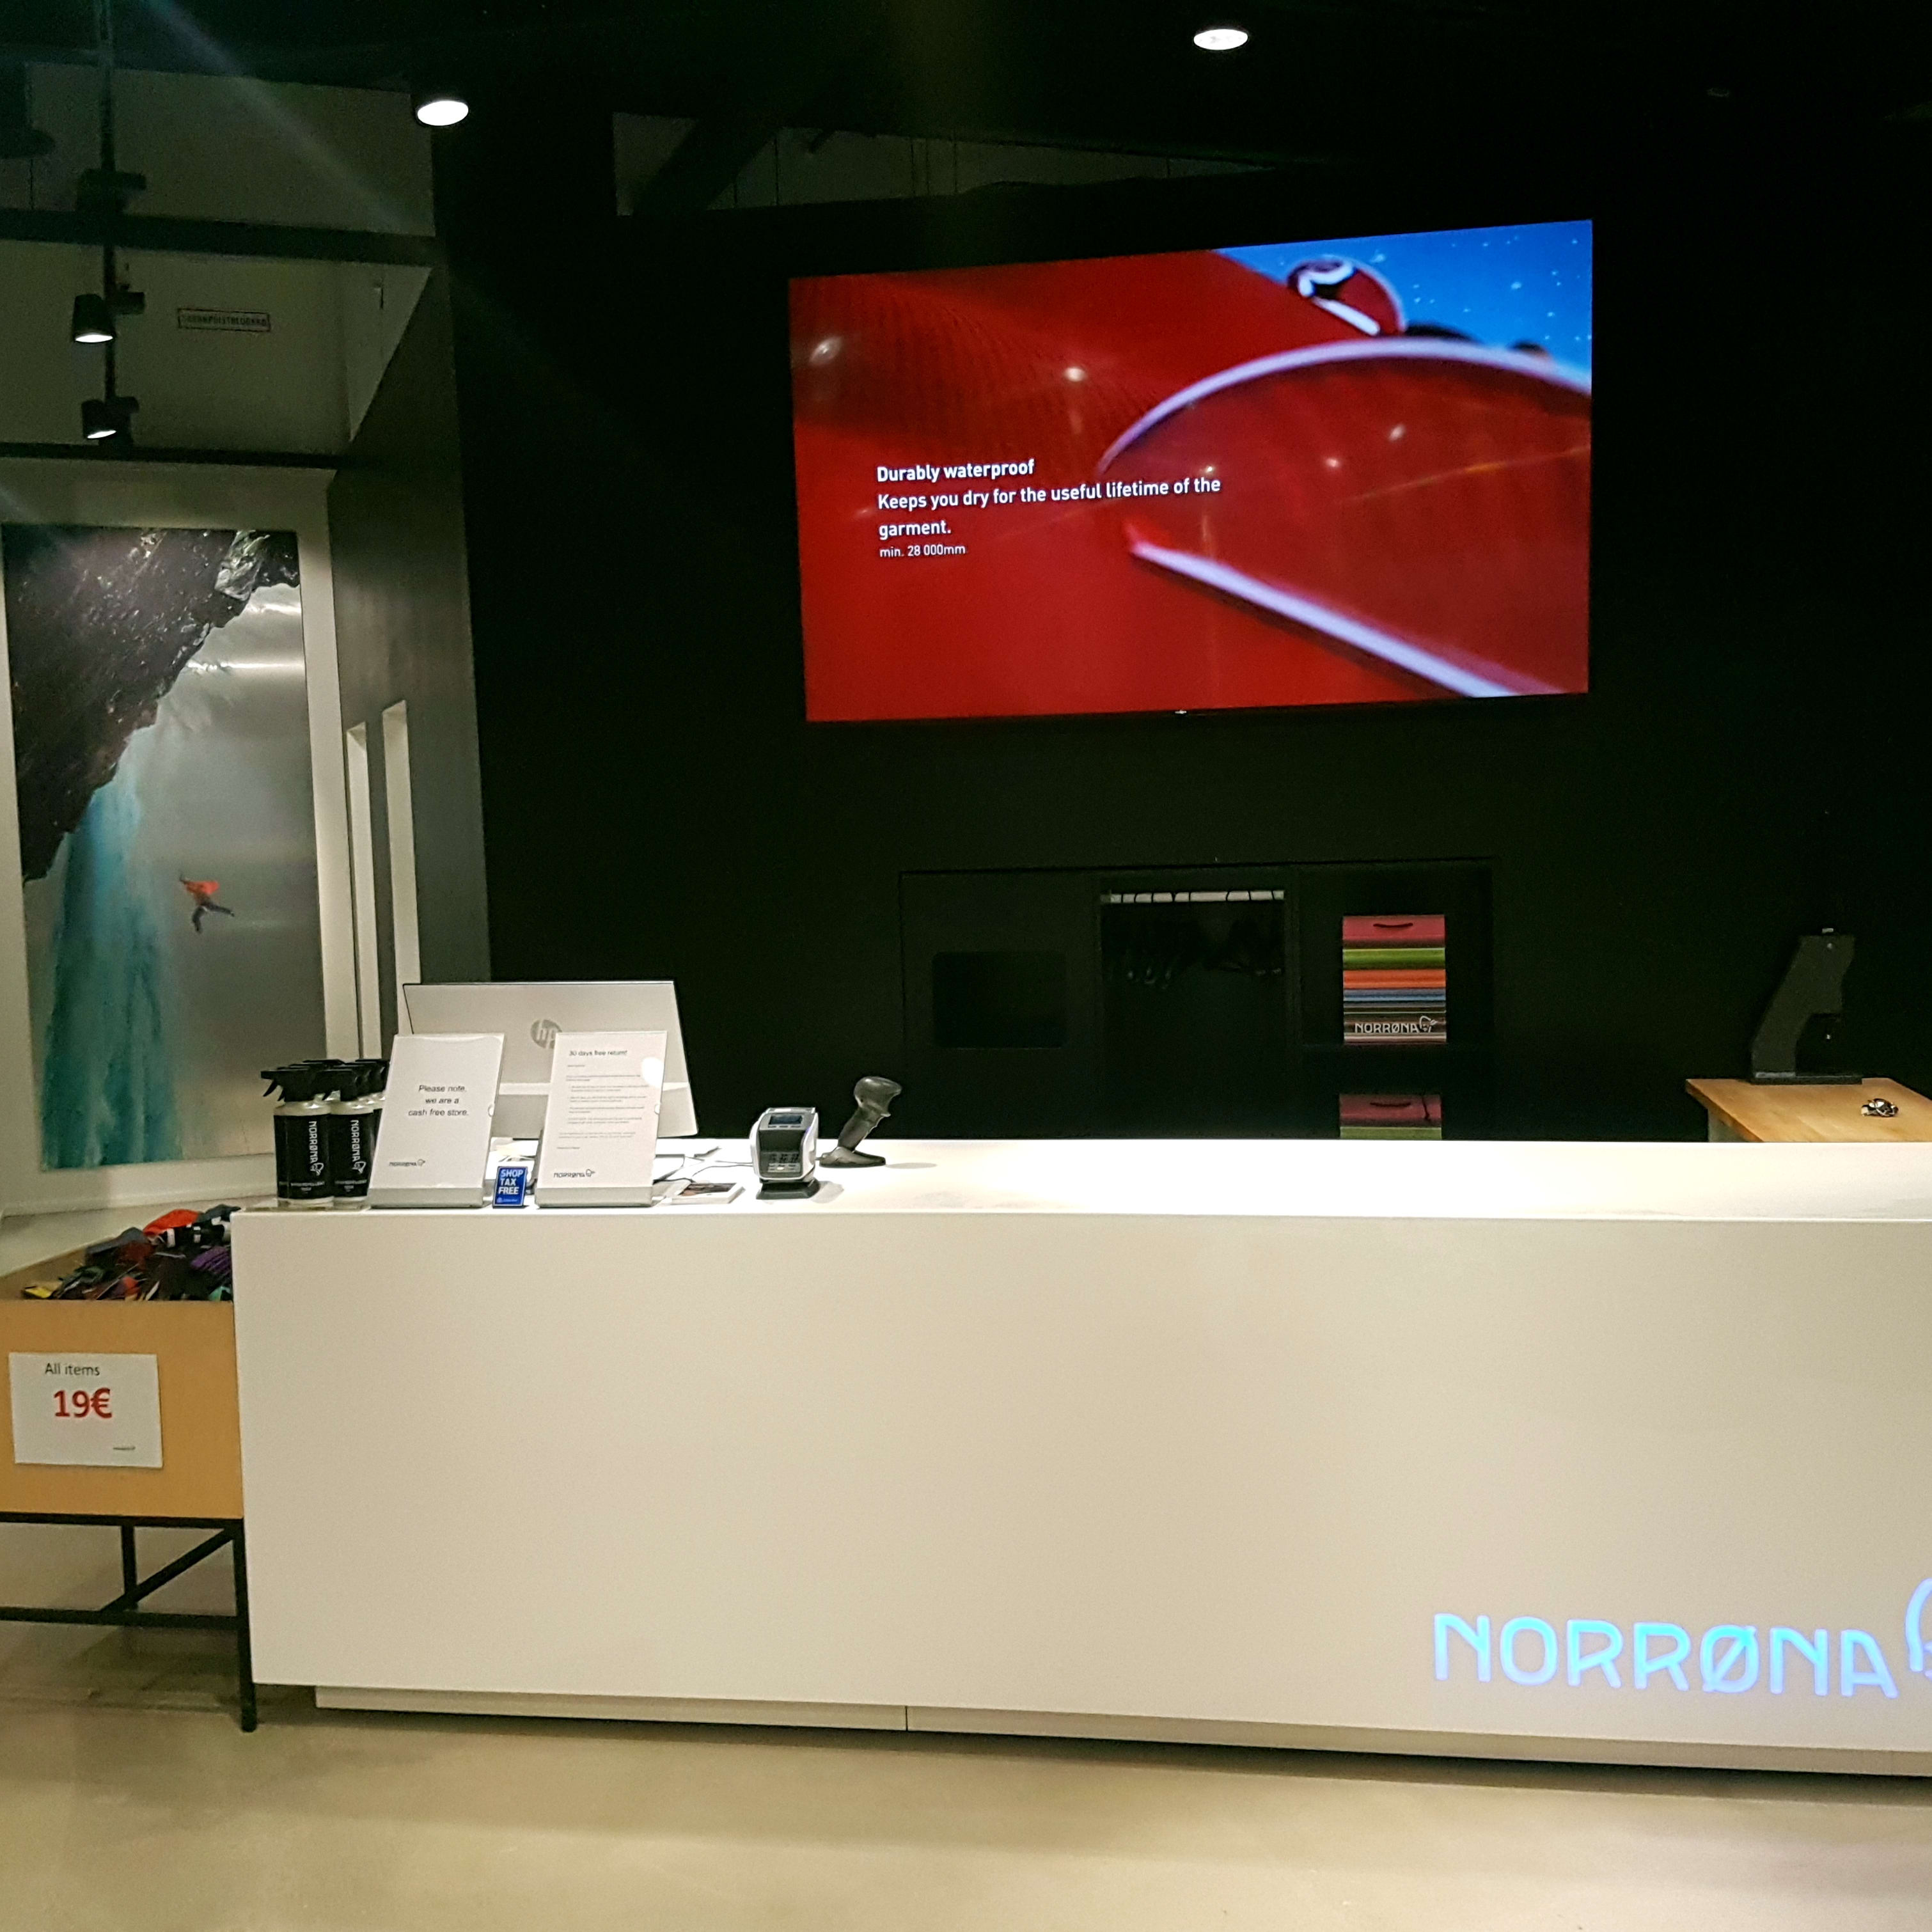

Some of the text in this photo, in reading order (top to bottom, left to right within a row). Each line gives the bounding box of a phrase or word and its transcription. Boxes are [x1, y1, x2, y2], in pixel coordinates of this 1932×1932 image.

[877, 458, 1035, 483] Durably waterproof
[878, 476, 1221, 512] Keeps you dry for the useful lifetime of the
[879, 520, 952, 541] garment.
[879, 543, 966, 558] min. 28 000mm
[1355, 1023, 1420, 1033] NORRØNA
[500, 1169, 524, 1178] SHOP
[500, 1178, 517, 1186] TAX
[498, 1186, 520, 1195] FREE
[45, 1362, 100, 1376] All items
[54, 1388, 113, 1419] 19€
[1434, 1613, 1900, 1699] NORRØNA
